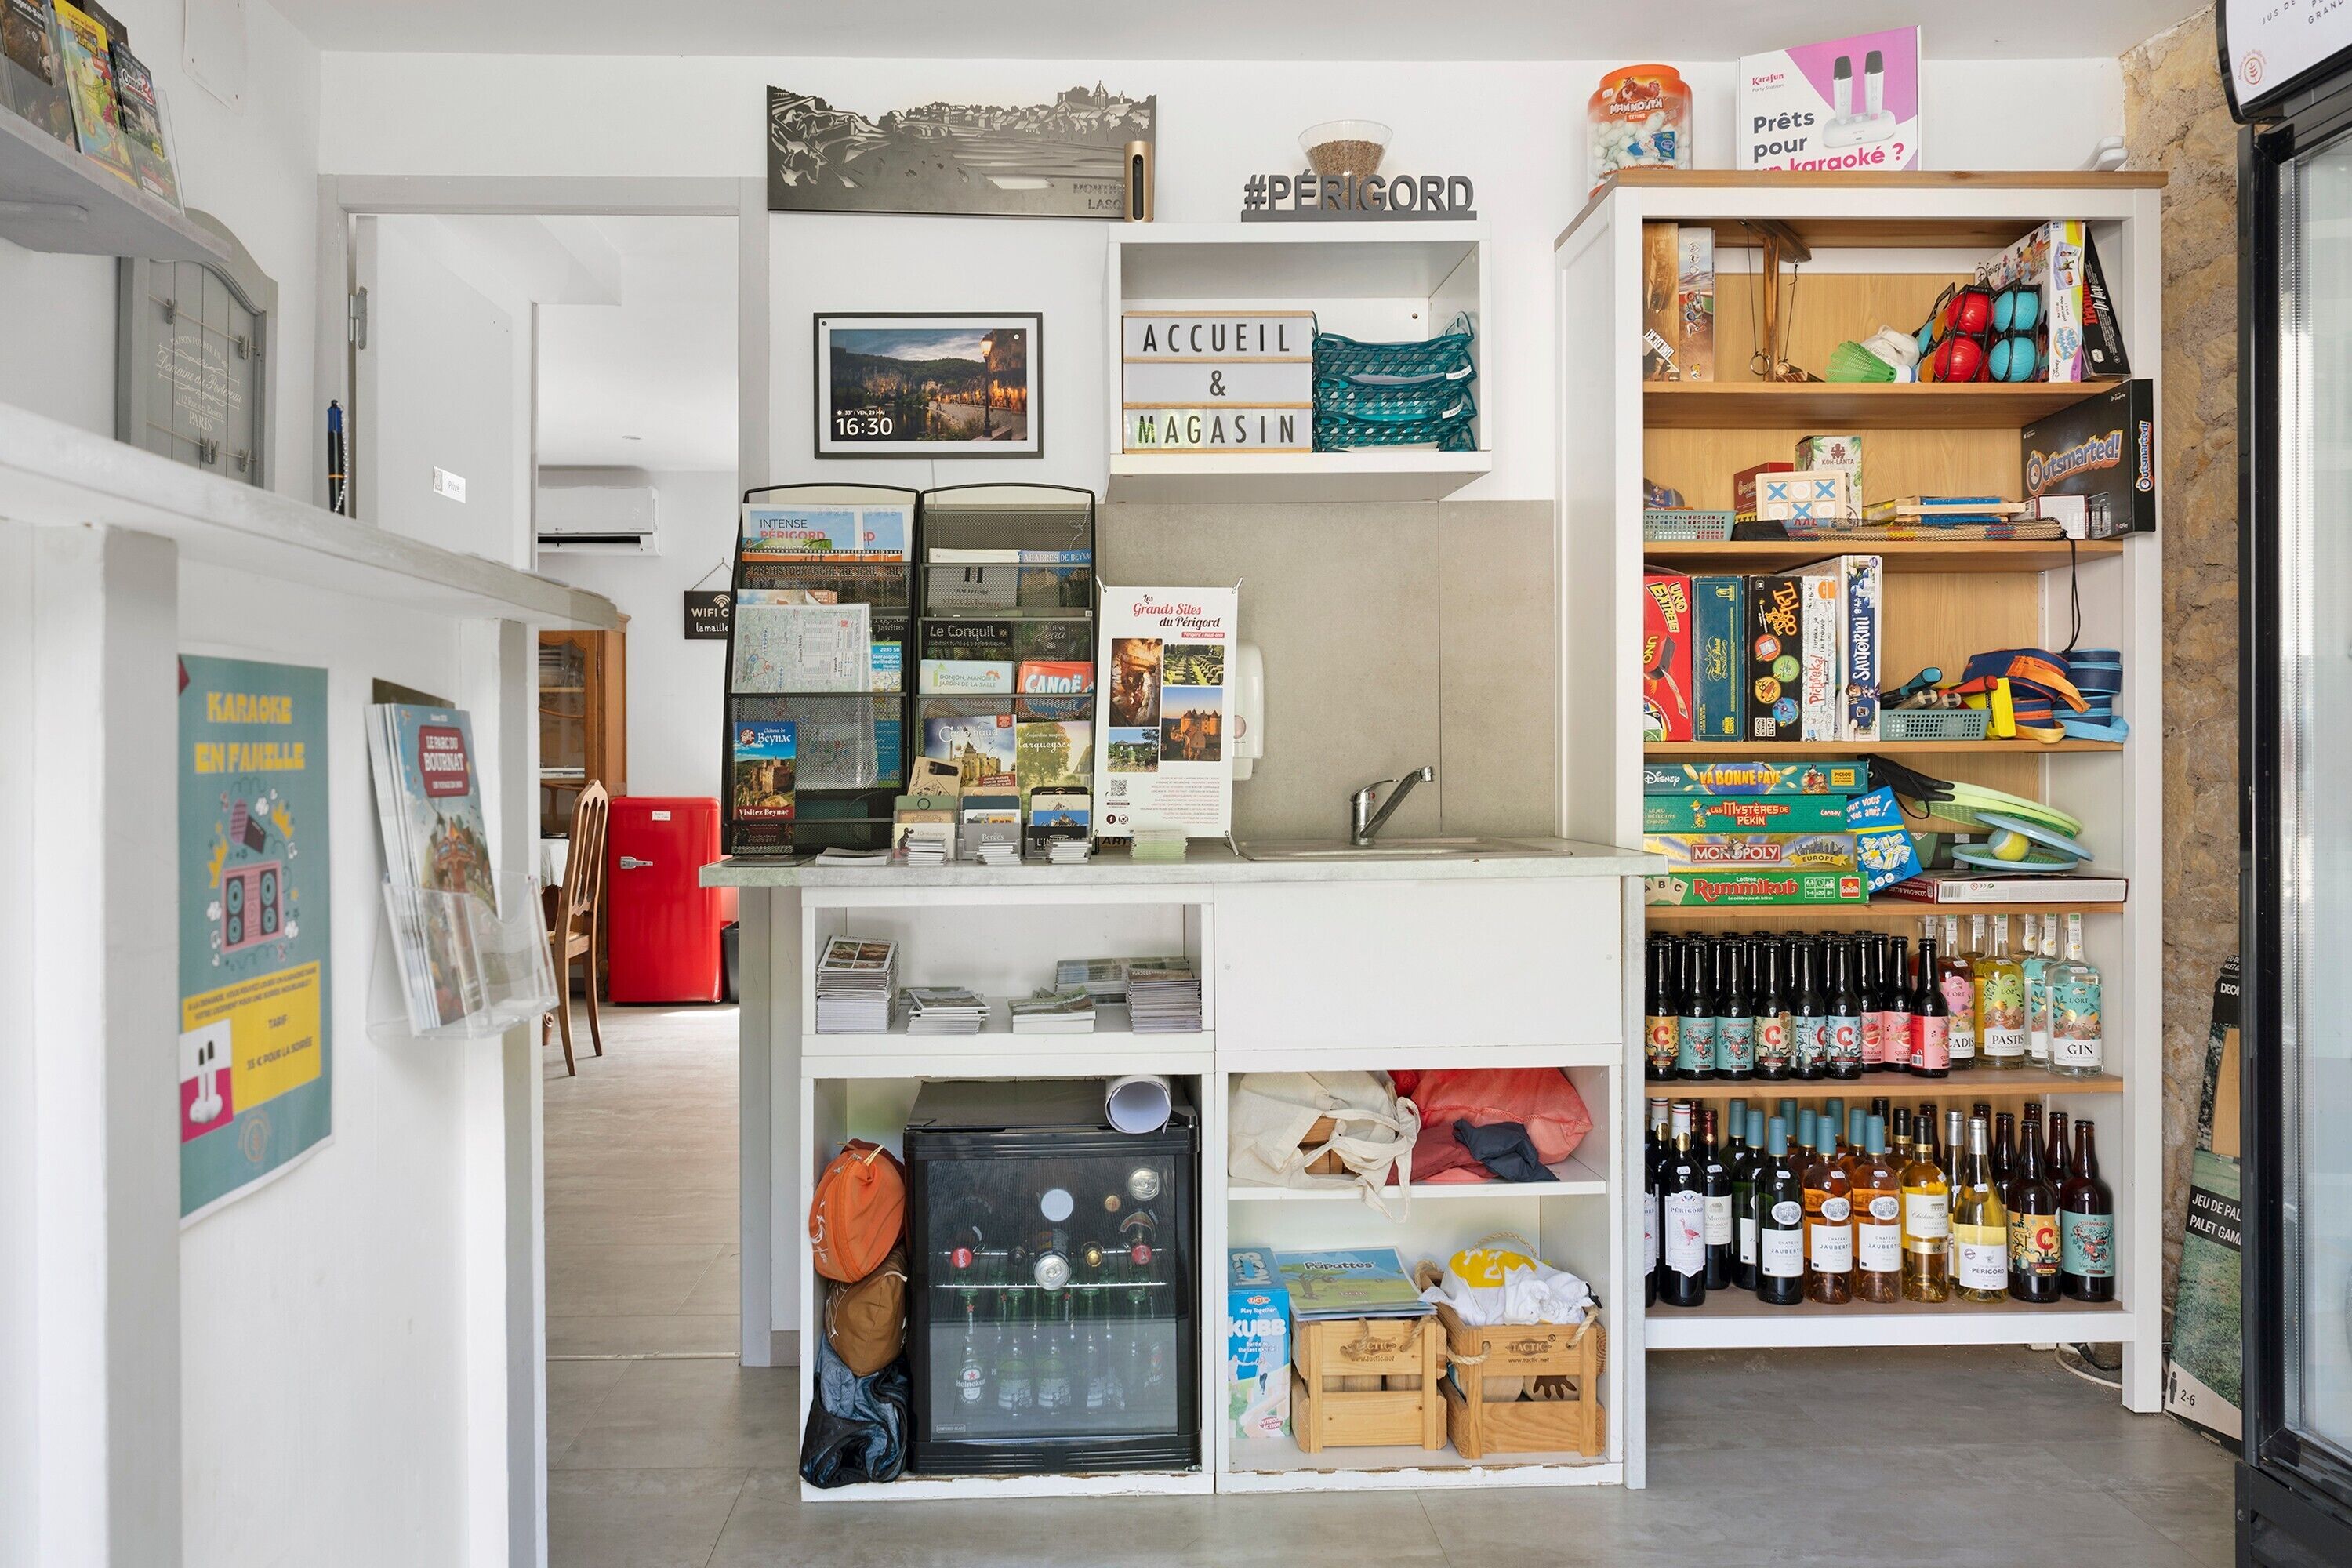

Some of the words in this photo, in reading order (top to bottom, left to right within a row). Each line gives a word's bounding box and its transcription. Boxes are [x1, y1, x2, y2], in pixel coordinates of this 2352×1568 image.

[2262, 9, 2278, 25] JUS
[1752, 73, 1784, 85] Karafun
[1610, 97, 1664, 115] MAMMOUTH
[1754, 111, 1815, 134] Prêts
[1754, 136, 1808, 164] pour
[1790, 146, 1885, 171] karaoké
[1892, 143, 1904, 161] ?
[1243, 169, 1475, 213] #PÉRIGORD
[1142, 322, 1290, 353] ACCUEIL
[156, 350, 194, 381] Domaine
[194, 376, 205, 387] du
[1210, 370, 1226, 396] &
[189, 411, 212, 431] PARIS
[836, 417, 893, 436] 16:30
[1138, 414, 1294, 444] MAGASIN
[2027, 430, 2123, 493] Outsmarted!
[2136, 420, 2154, 492] Outsmarted!
[448, 479, 460, 493] Privé
[760, 518, 808, 528] INTENSE
[760, 528, 826, 539] PÉRIGORD
[1143, 594, 1153, 604] Les
[1668, 582, 1688, 613] UNO
[691, 608, 719, 618] WIFI
[1133, 602, 1174, 617] Grands
[1176, 603, 1202, 615] Sites
[1159, 617, 1174, 627] du
[1175, 616, 1221, 630] Périgord
[930, 625, 944, 637] Le
[947, 625, 996, 641] Conquil
[1644, 635, 1659, 664] UNO
[1025, 674, 1083, 693] CANOË
[1809, 654, 1826, 706] Pictureka!
[206, 691, 293, 724] KARAOKE
[450, 736, 459, 750] DU
[757, 733, 792, 746] Beynac
[194, 742, 225, 774] EN
[227, 742, 306, 773] FAMILLE
[423, 752, 464, 771] BOURNAT
[1644, 770, 1681, 786] Disney
[1715, 769, 1755, 786] BONNE
[1757, 770, 1782, 784] PAYE
[764, 808, 789, 818] Beynac
[1723, 801, 1779, 816] MYSTÈRES
[1737, 814, 1766, 826] PÉKIN
[1694, 846, 1779, 860] MONOPOLY
[1658, 880, 1666, 889] B
[1674, 884, 1682, 892] C
[1693, 877, 1799, 902] Rummikub
[1842, 885, 1859, 894] Goliath
[1653, 1025, 1669, 1045] C
[1765, 1025, 1781, 1045] C
[1836, 1026, 1853, 1046] C
[1992, 1035, 2024, 1045] PASTIS
[263, 1050, 281, 1065] POUR
[282, 1047, 290, 1057] LA
[291, 1036, 314, 1053] SOIRÉE
[2067, 1044, 2093, 1055] GIN
[2192, 1192, 2209, 1210] JEU
[2210, 1200, 2223, 1216] DE
[2190, 1214, 2217, 1236] PALET
[2035, 1227, 2053, 1250] C
[1512, 1343, 1547, 1352] TACTIC
[1351, 1354, 1395, 1363] www.tactic.net
[956, 1378, 985, 1388] Heineken
[2180, 1388, 2196, 1406] 2-6
